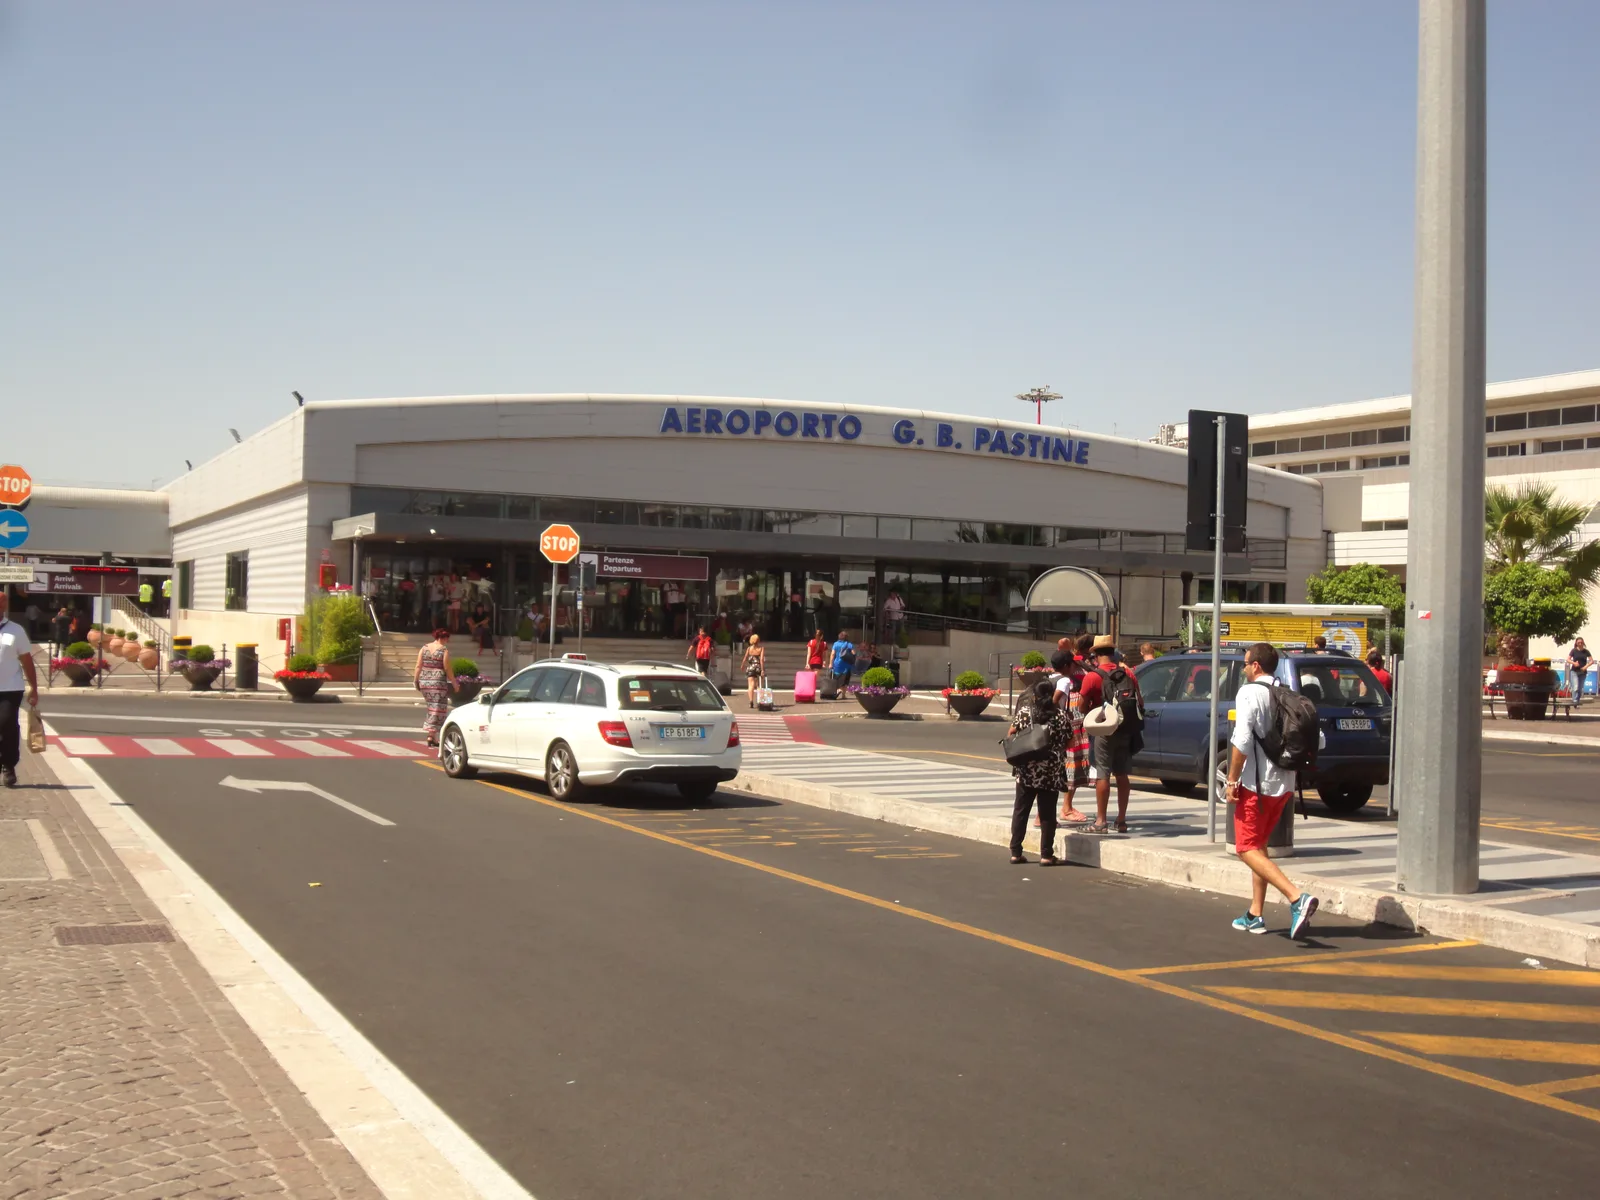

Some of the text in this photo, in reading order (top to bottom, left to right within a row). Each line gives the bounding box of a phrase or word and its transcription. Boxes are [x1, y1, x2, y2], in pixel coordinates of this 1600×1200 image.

[659, 407, 1090, 465] AEROPORTO G. B. PASTINE
[0, 476, 30, 493] TOP
[543, 535, 577, 552] STOP
[603, 555, 635, 564] Partenze
[603, 564, 642, 573] Departures
[54, 583, 82, 591] Arrivals
[198, 727, 353, 738] STOP
[665, 727, 700, 737] EP 618FX
